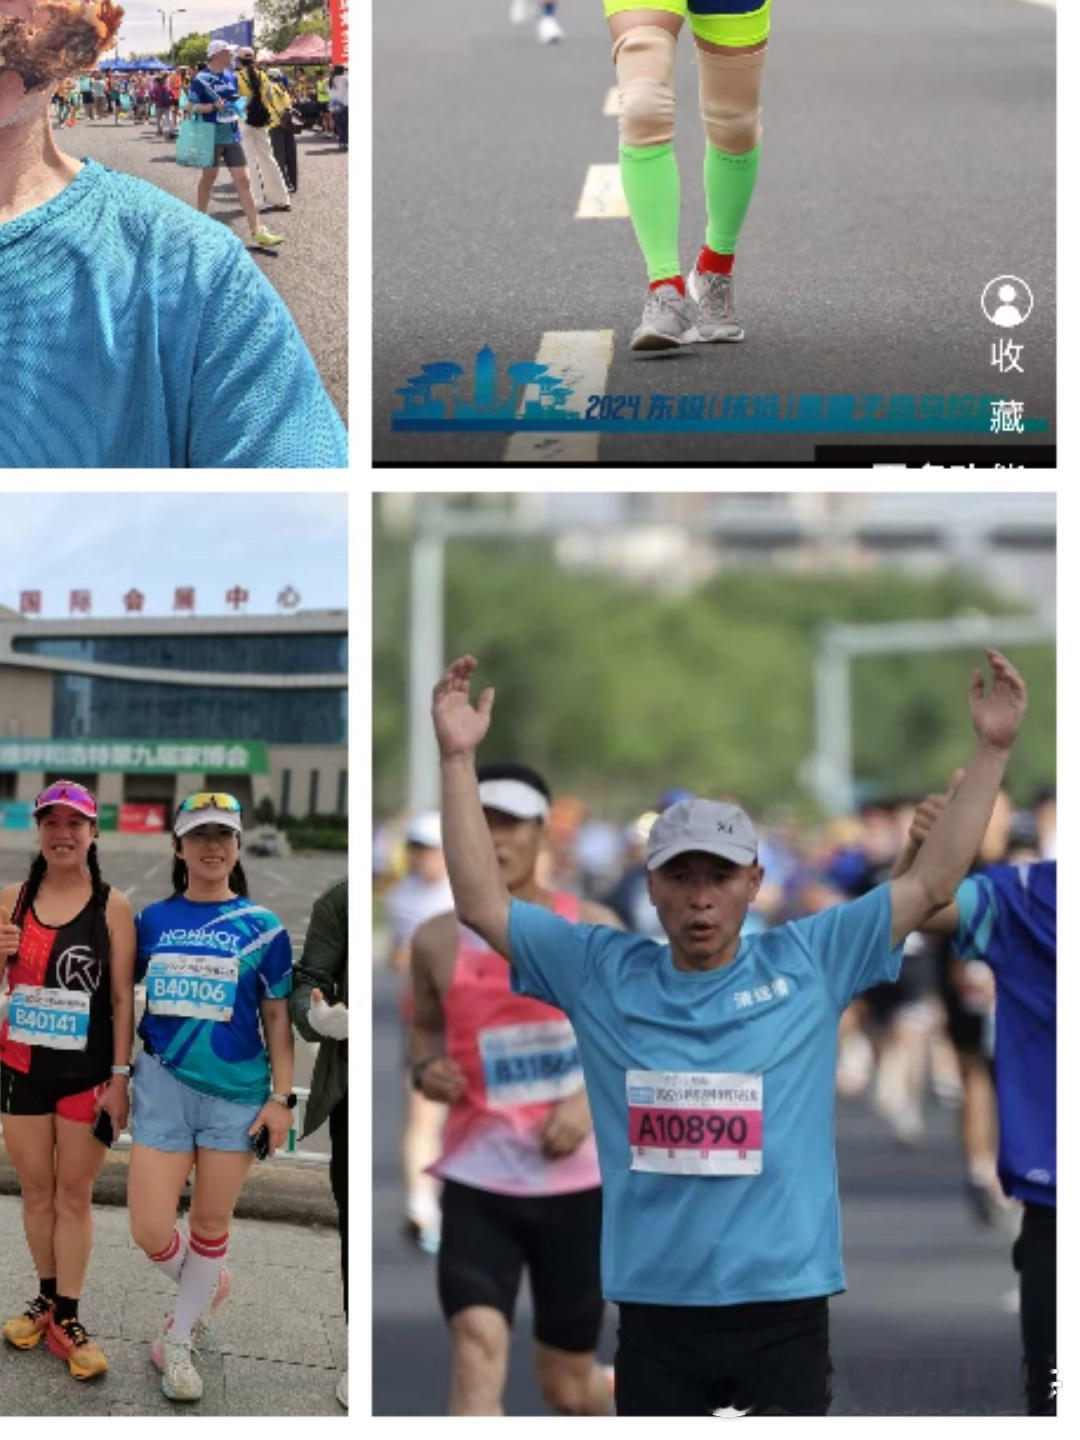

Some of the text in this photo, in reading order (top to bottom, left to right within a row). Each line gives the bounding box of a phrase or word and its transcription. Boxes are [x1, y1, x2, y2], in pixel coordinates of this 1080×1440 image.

[154, 979, 225, 1002] B40106
[15, 1009, 77, 1032] B40141
[638, 1113, 749, 1144] A10890
